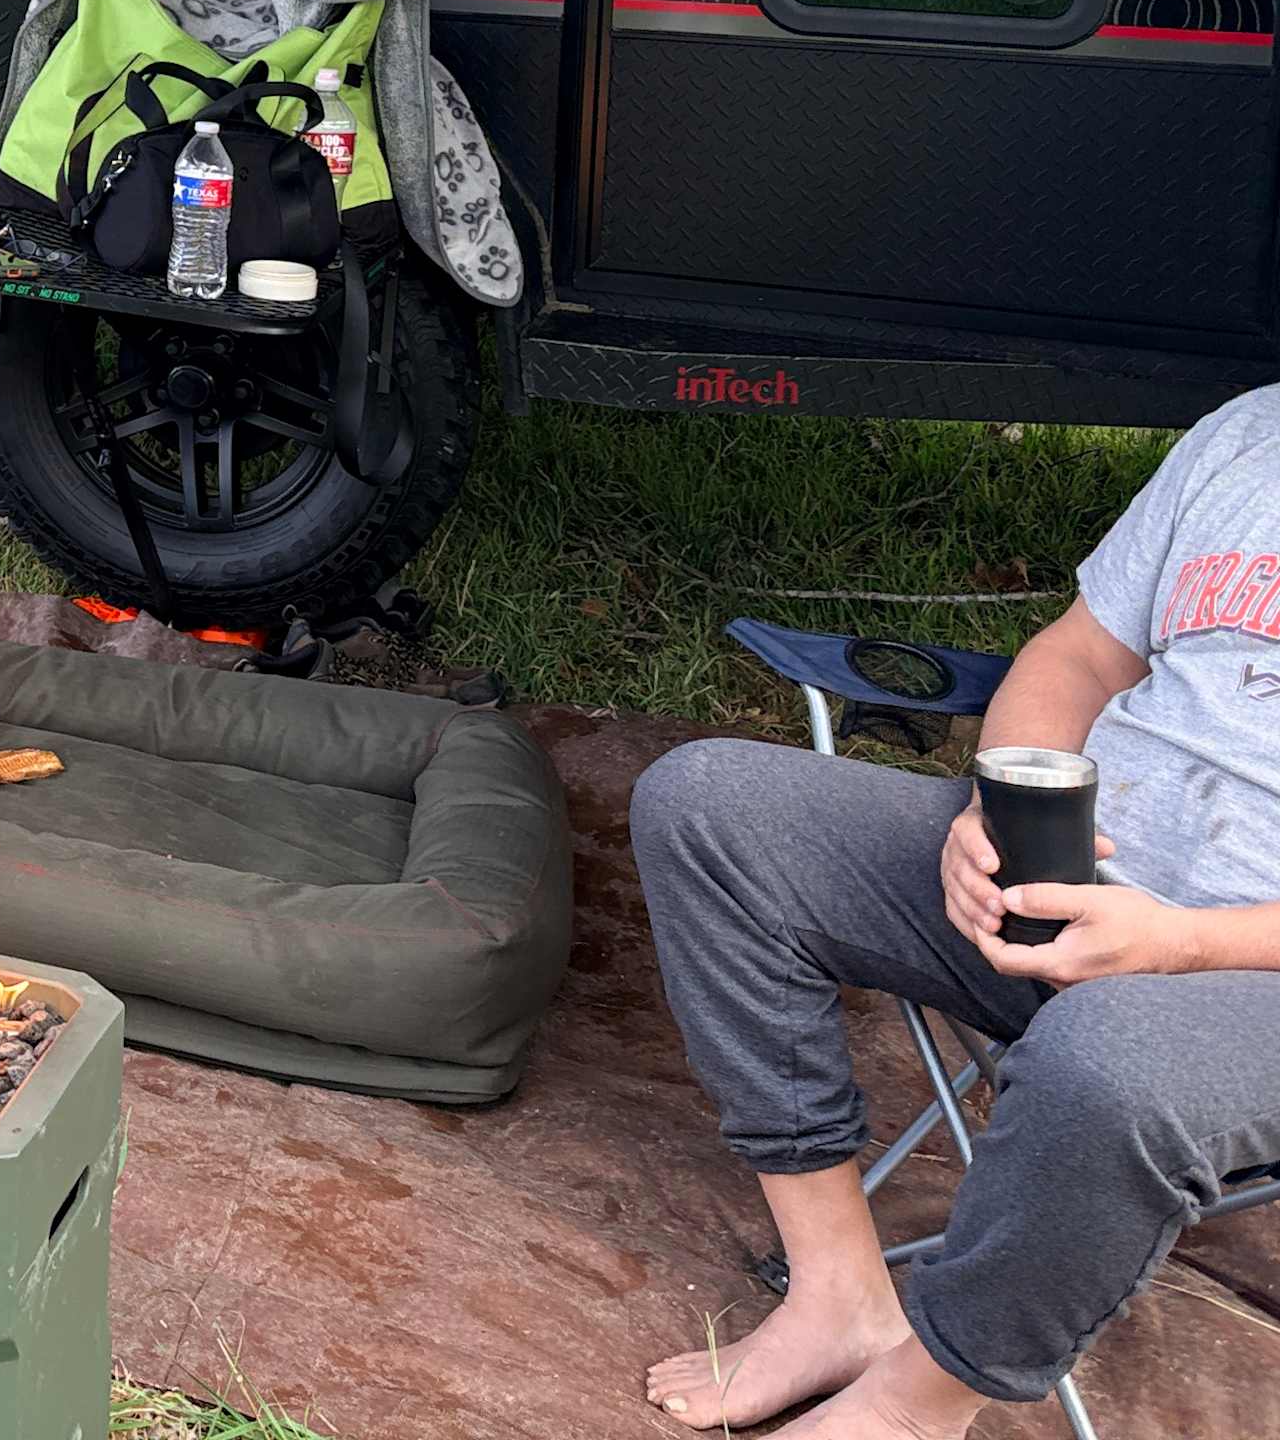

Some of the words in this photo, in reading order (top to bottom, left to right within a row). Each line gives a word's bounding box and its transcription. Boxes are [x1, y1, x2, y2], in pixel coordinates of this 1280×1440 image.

[2, 283, 17, 295] NO
[676, 366, 800, 404] inTech
[1159, 549, 1280, 642] VIRGI
